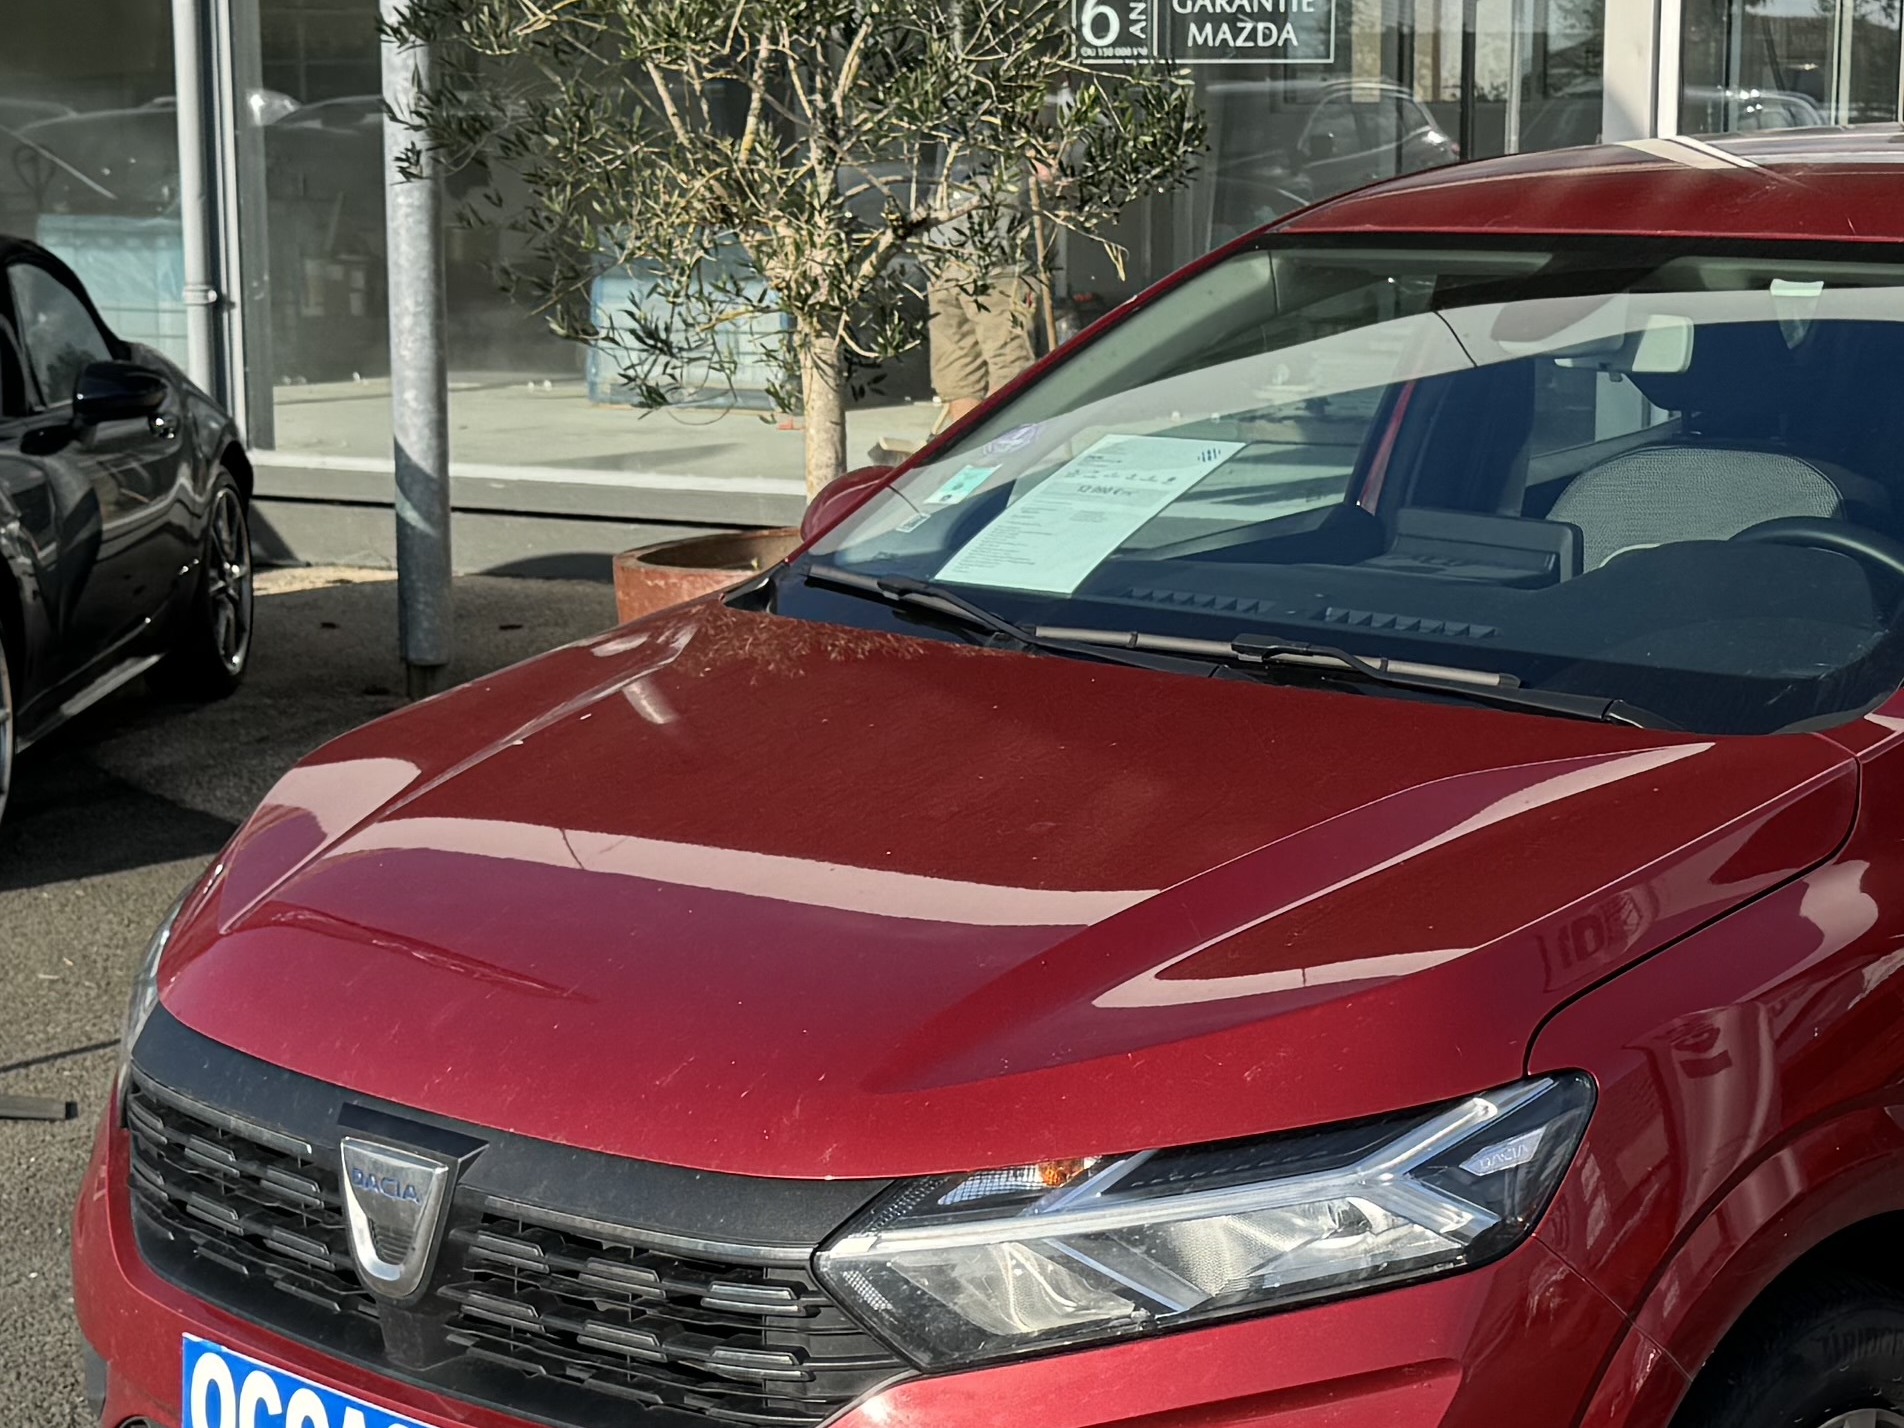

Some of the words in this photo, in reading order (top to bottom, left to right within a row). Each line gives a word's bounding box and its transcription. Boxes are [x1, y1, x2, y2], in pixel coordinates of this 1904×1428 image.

[1186, 22, 1299, 48] MAZDA
[1479, 1144, 1529, 1170] DACIA
[351, 1166, 421, 1205] DACIA
